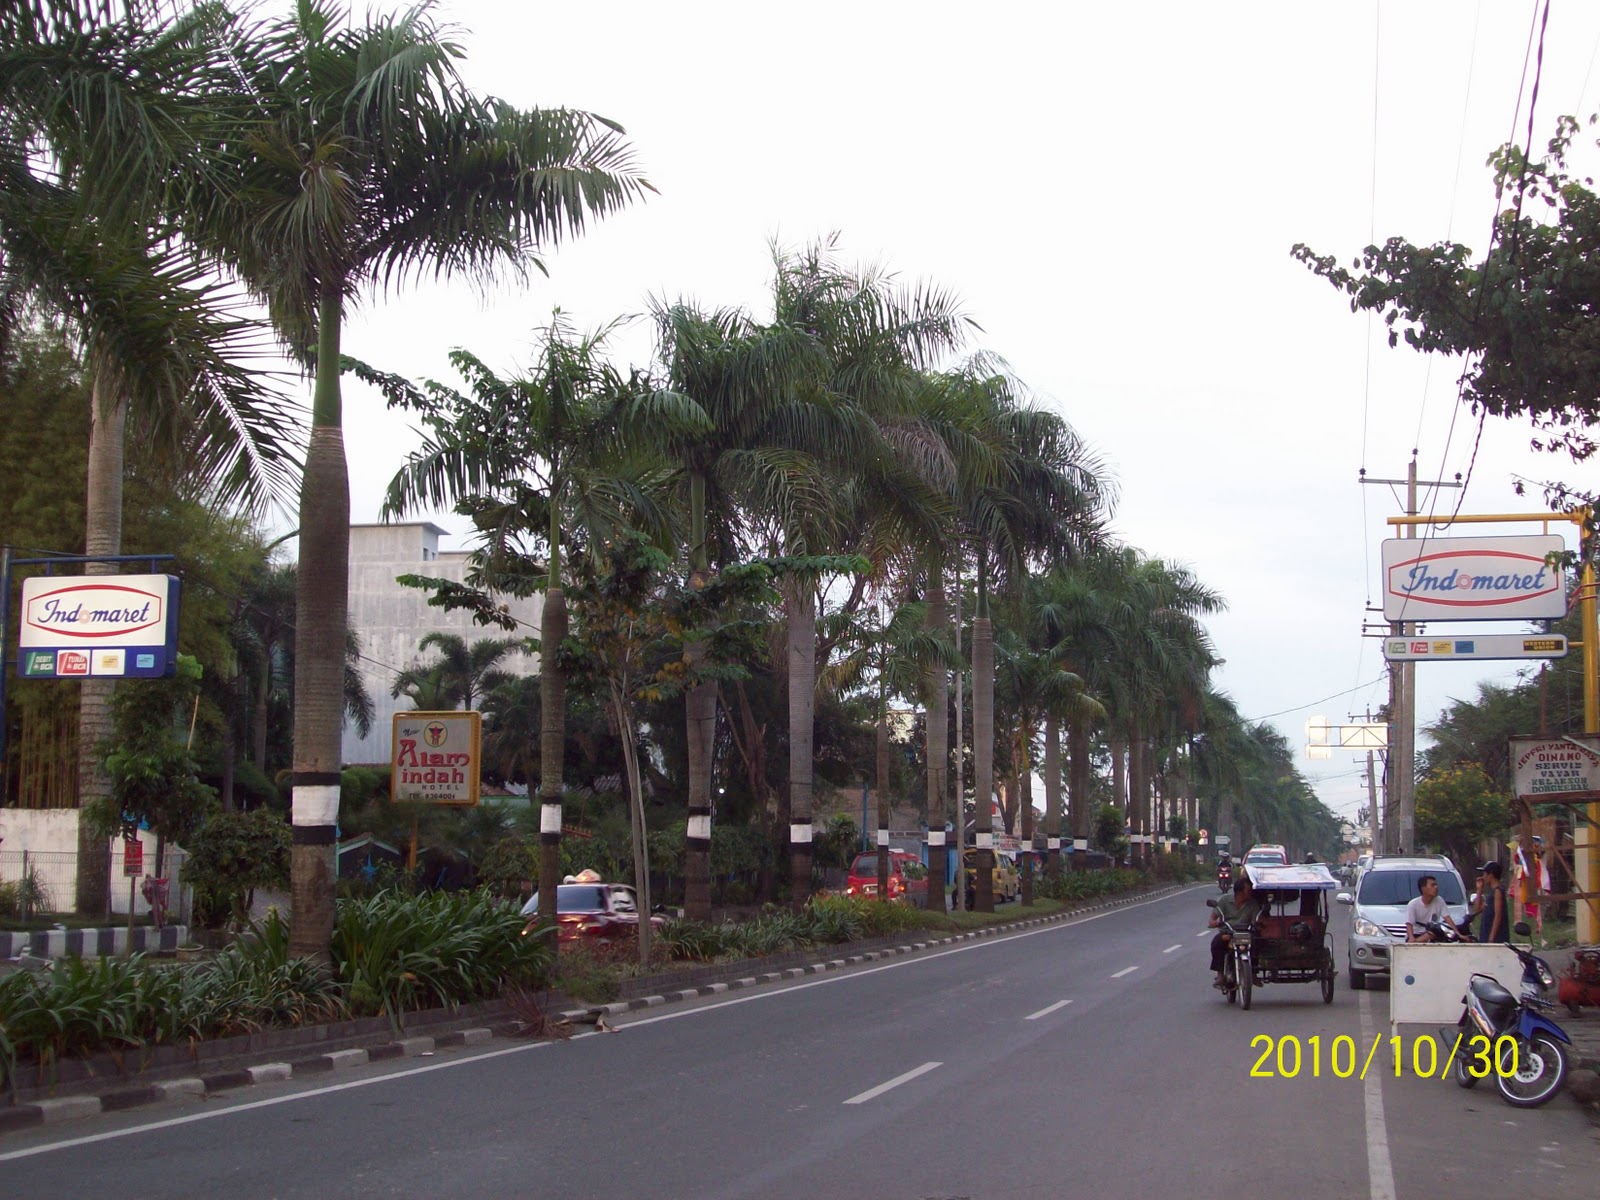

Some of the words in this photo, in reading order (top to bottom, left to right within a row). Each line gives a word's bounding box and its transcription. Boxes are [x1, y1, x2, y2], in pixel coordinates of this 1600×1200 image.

[1401, 564, 1546, 592] Indomaret
[37, 599, 151, 624] Indomaret
[1538, 752, 1581, 762] DINAMO
[402, 768, 464, 784] indah
